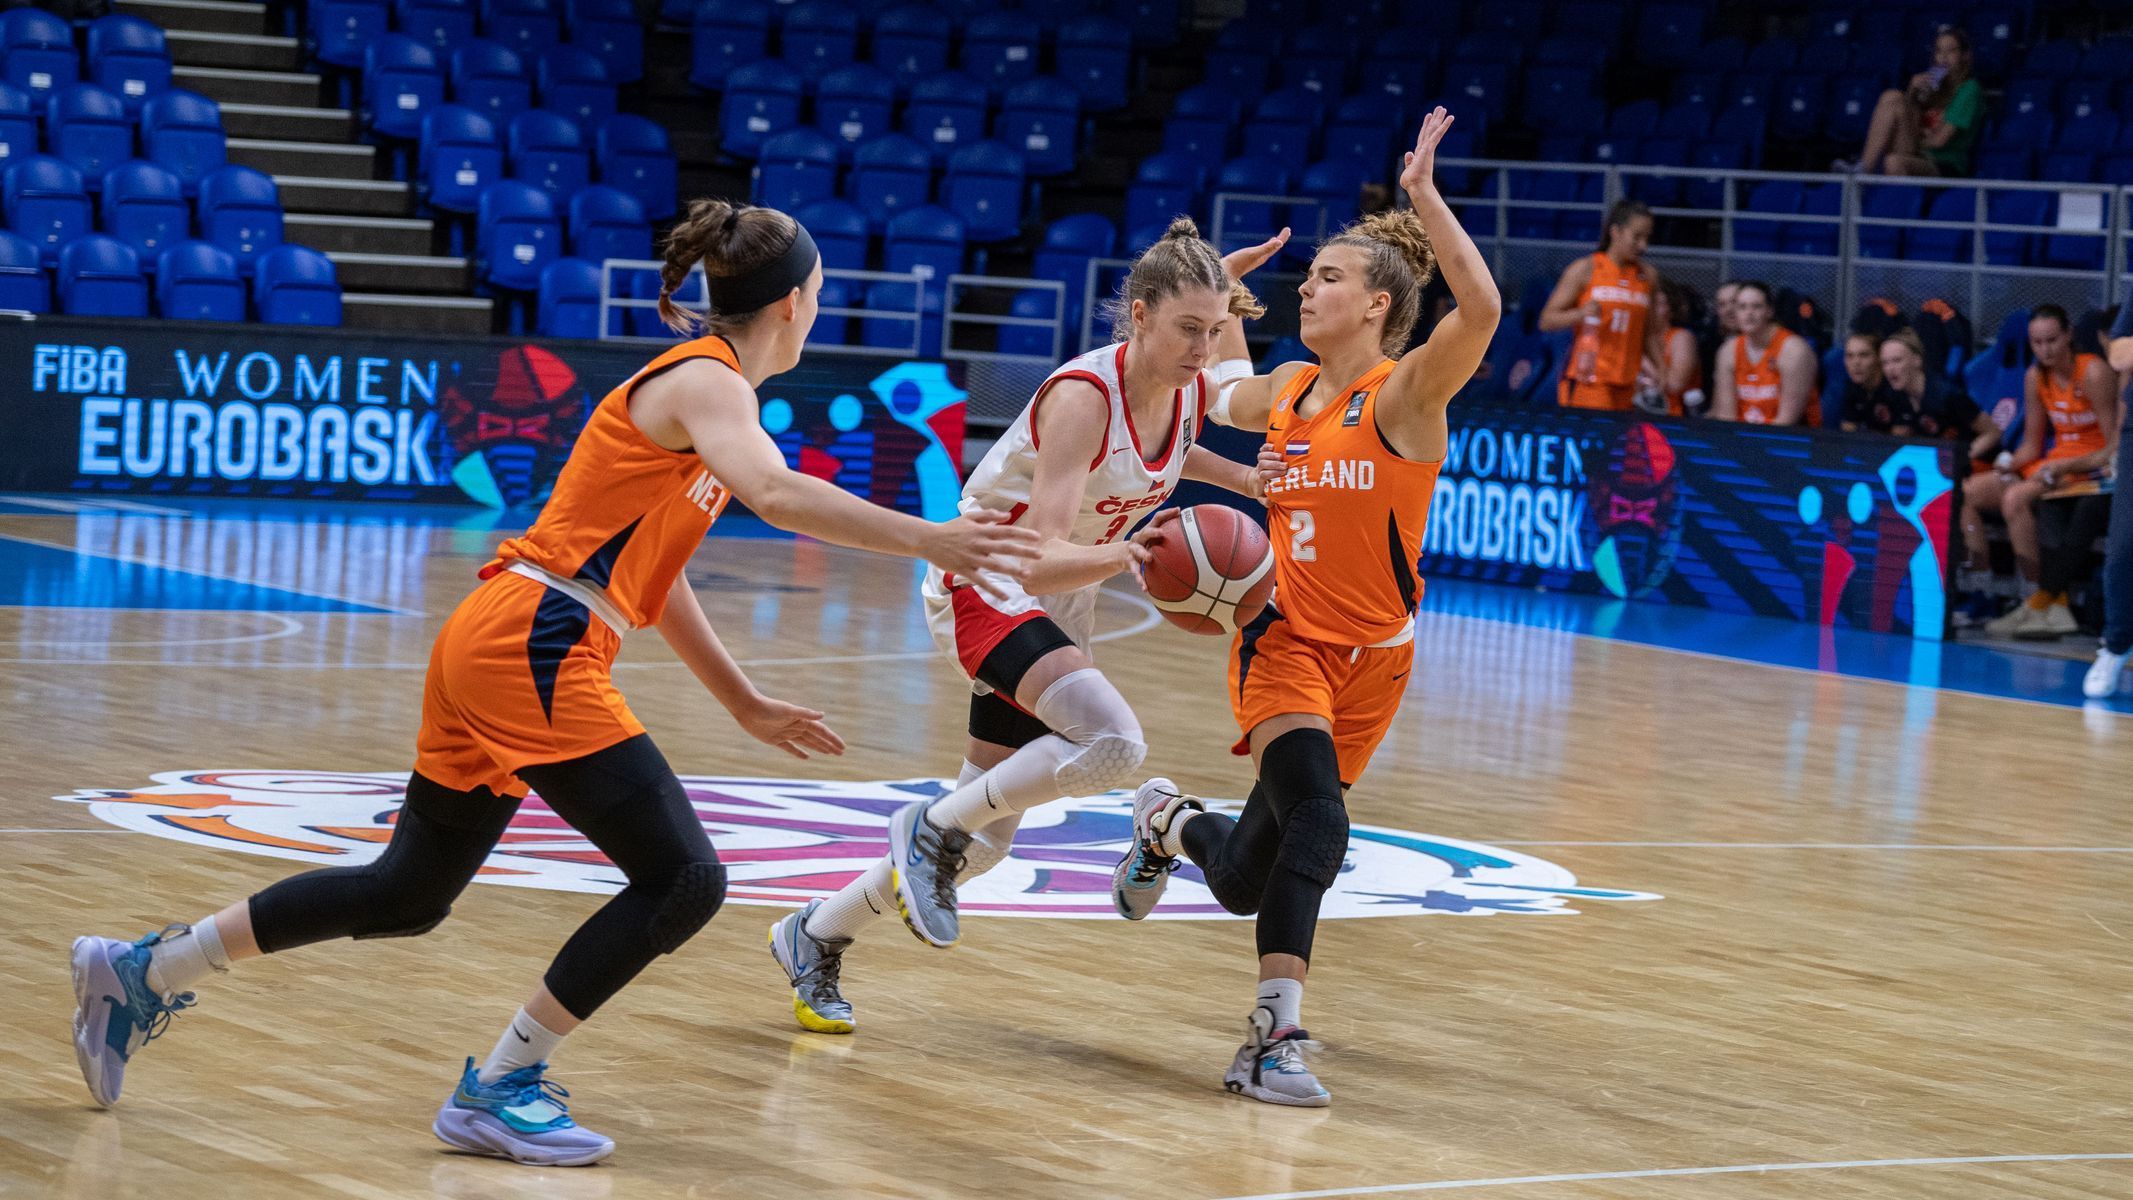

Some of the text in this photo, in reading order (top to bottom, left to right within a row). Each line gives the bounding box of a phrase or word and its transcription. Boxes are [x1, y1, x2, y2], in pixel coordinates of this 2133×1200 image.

[33, 344, 439, 403] FIBA WOMEN
[78, 397, 437, 485] EUROBASK
[1290, 510, 1317, 562] 2
[1422, 476, 1588, 571] ROBASK
